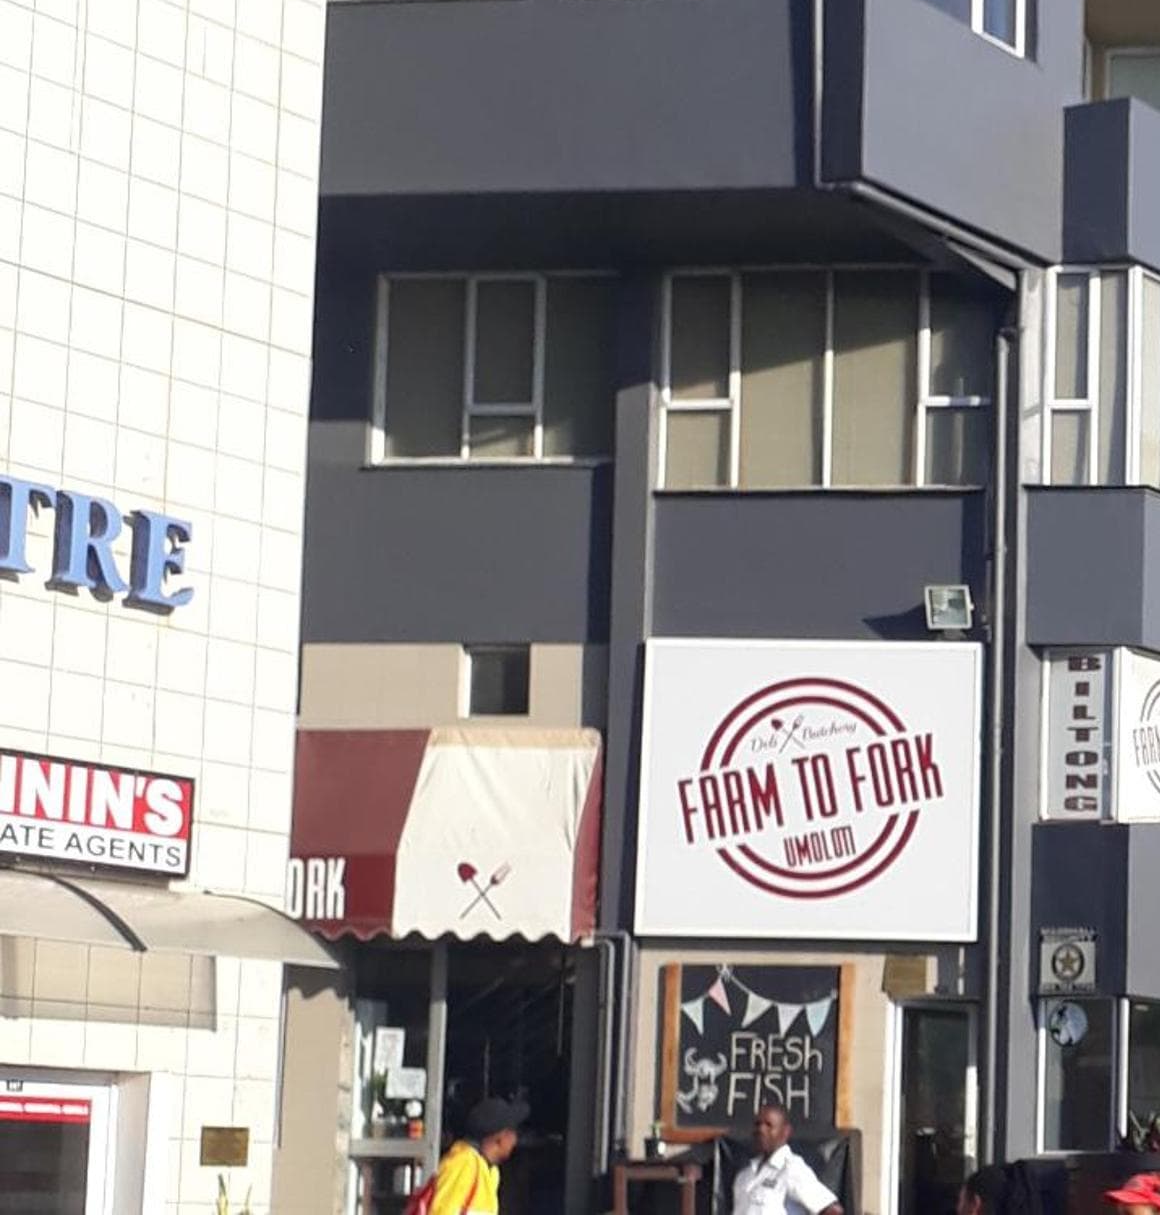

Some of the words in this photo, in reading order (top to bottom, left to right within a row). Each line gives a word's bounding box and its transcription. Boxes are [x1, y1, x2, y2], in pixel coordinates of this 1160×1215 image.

[0, 474, 194, 610] TRE
[1064, 656, 1101, 812] BILTONG
[677, 762, 784, 845] FARM
[791, 752, 838, 821] TO
[846, 733, 943, 813] FORK
[0, 823, 54, 849] ATE
[65, 832, 181, 868] AGENTS
[288, 857, 346, 920] ORK
[727, 1073, 809, 1118] FISH
